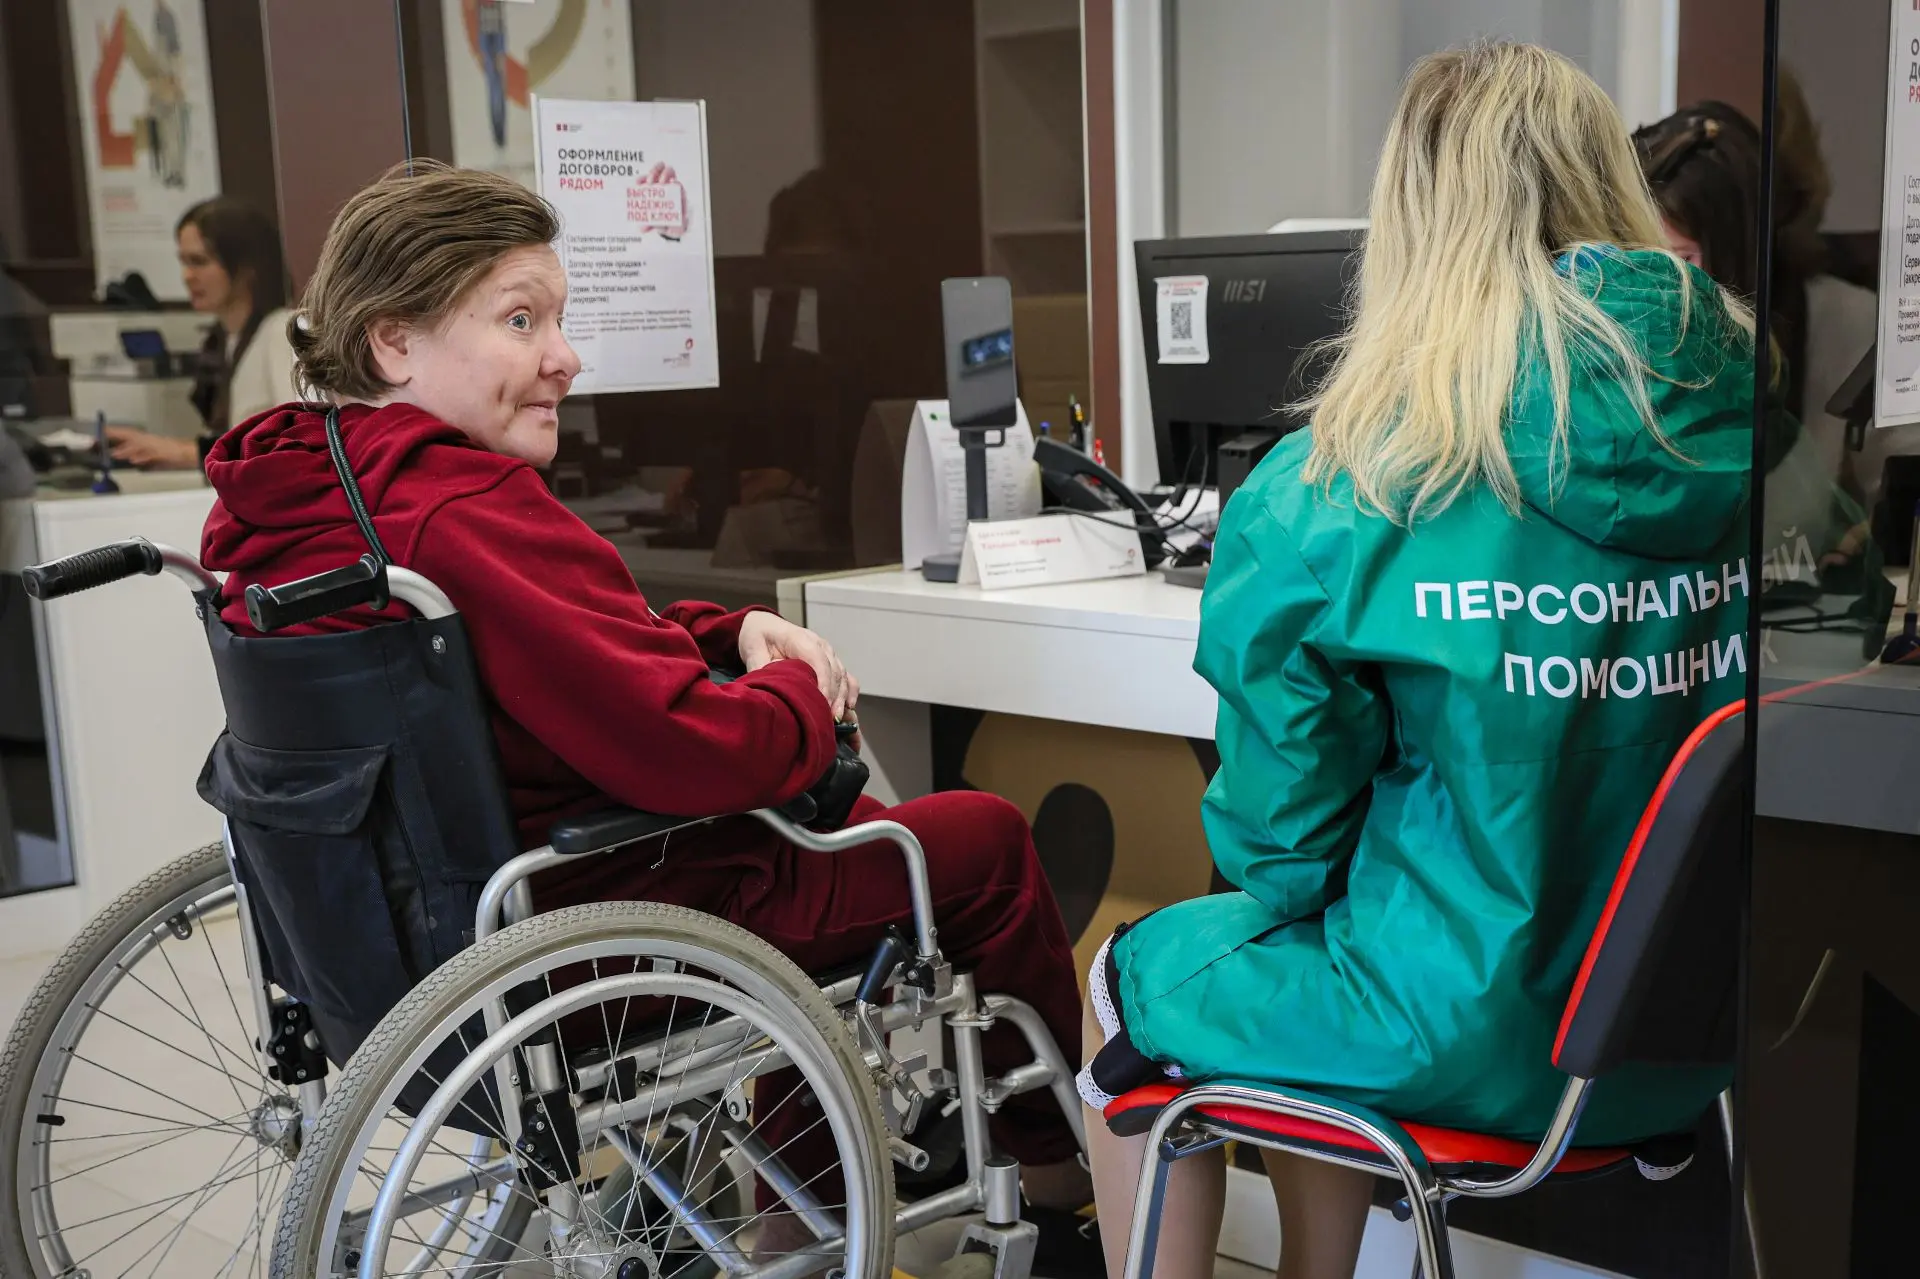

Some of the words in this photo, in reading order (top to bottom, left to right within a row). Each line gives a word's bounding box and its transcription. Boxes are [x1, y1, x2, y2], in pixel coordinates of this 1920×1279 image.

[558, 148, 645, 162] ОФОРМЛЕНИЕ
[559, 163, 634, 176] ДОГОВОРОВ
[560, 178, 604, 191] РЯДОМ
[626, 187, 666, 199] БЫСТРО
[627, 211, 648, 222] ПОД
[651, 211, 679, 221] КЛЮЧ
[1223, 279, 1267, 302] MSI
